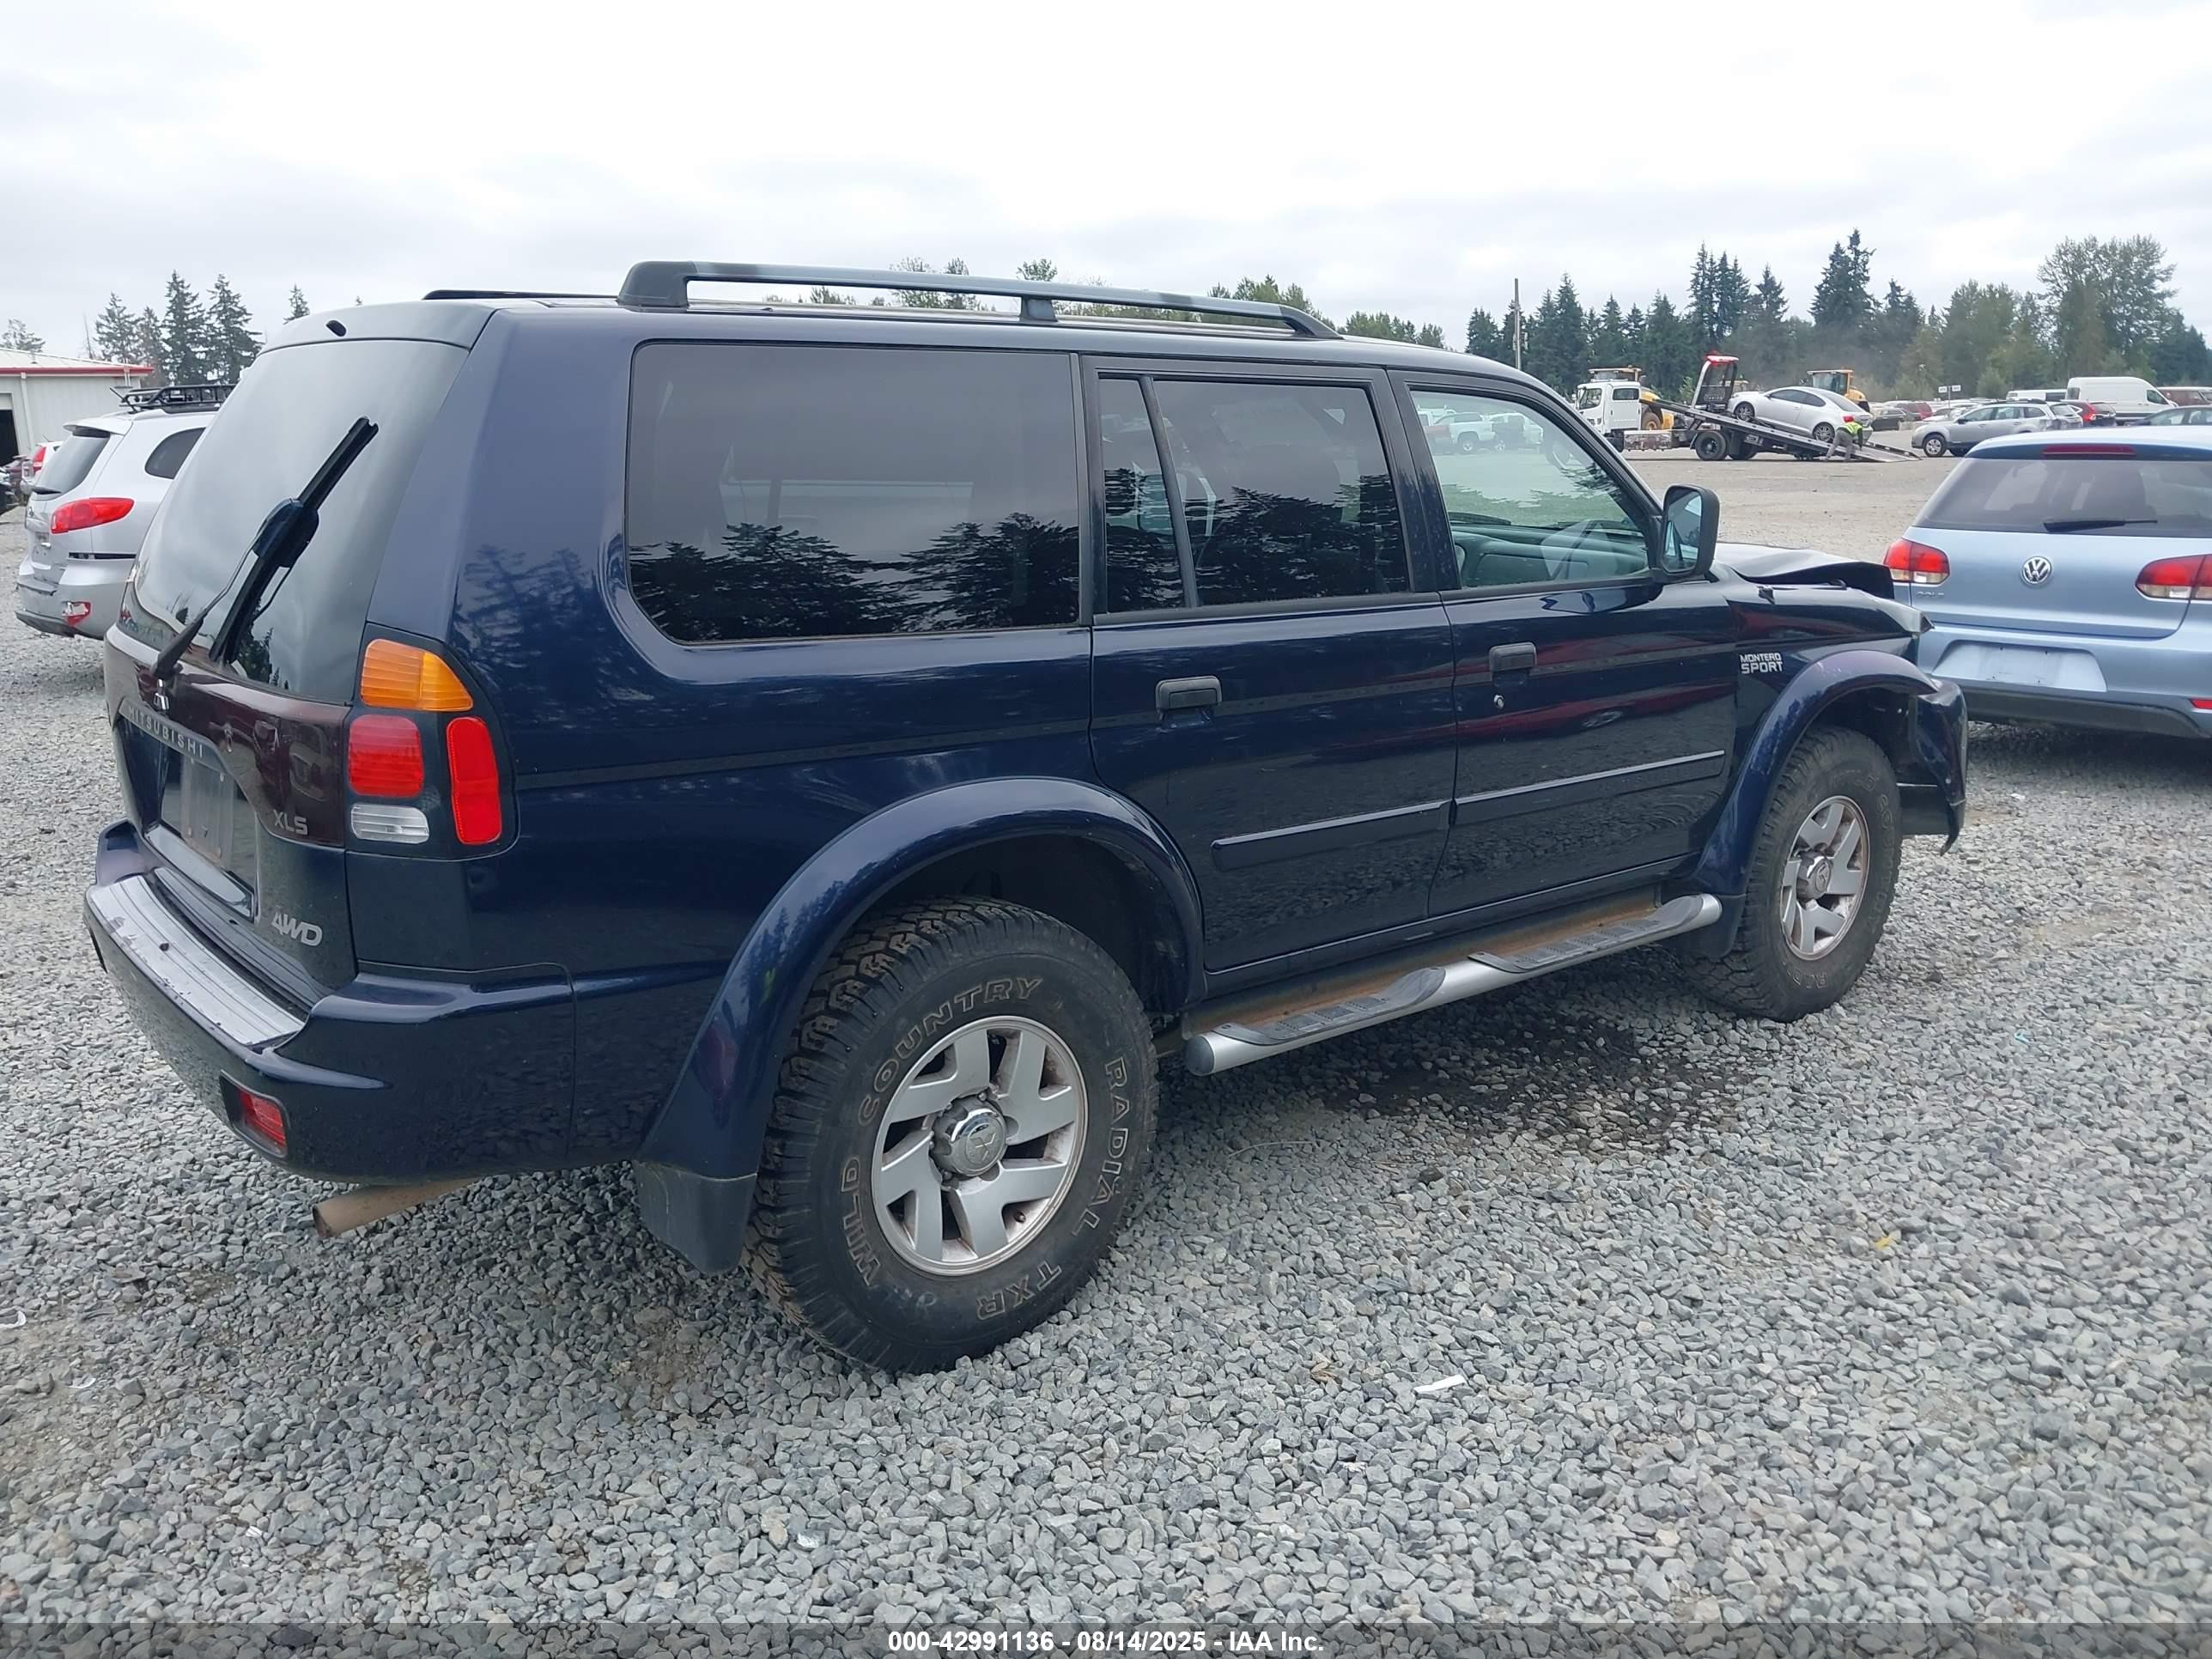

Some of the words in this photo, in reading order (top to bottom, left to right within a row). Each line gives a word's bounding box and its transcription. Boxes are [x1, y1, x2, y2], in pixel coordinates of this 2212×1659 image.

[1739, 653, 1782, 663] MONTERO
[1741, 661, 1784, 674] SPORT
[129, 705, 203, 759] MITSUBISHI
[273, 809, 308, 836] XLS
[271, 911, 323, 946] 4WD
[860, 977, 1043, 1127] COUNTRY
[1072, 1056, 1130, 1236] RADIAL
[842, 1156, 881, 1286] WILD
[975, 1261, 1062, 1321] TXR
